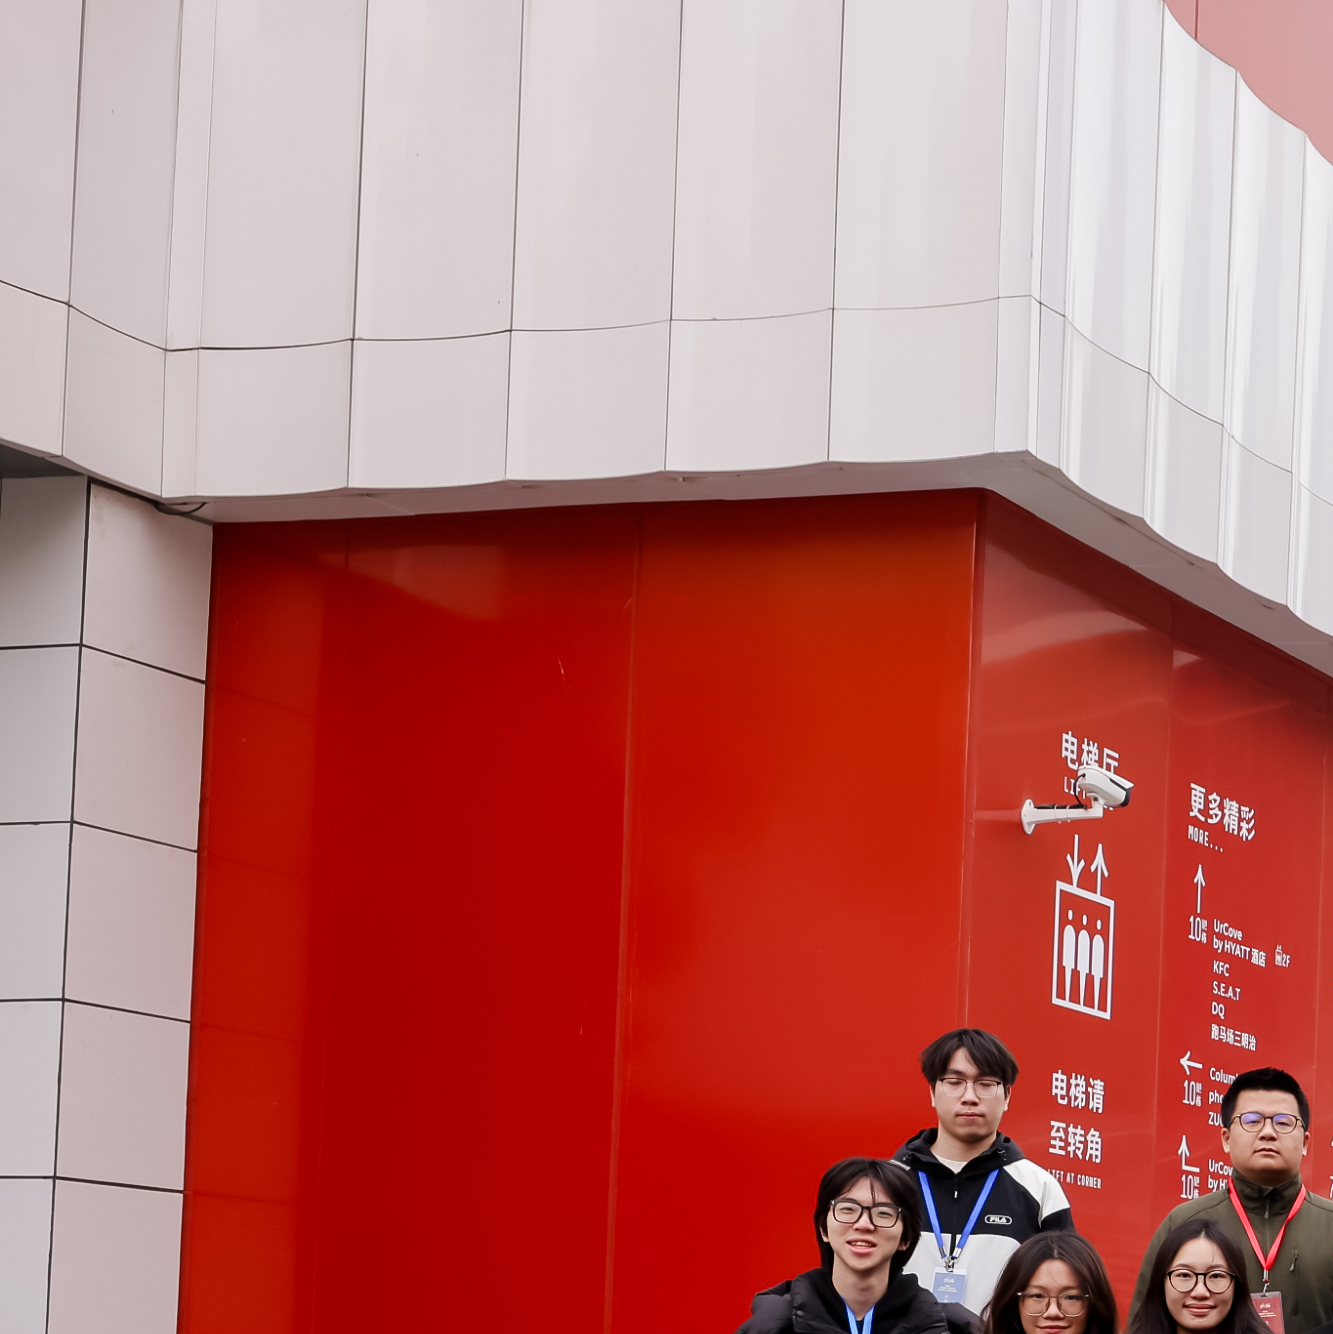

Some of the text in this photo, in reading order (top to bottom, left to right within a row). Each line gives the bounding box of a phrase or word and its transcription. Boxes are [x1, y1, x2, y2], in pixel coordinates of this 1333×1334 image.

[1189, 782, 1256, 842] 更多精彩
[1187, 824, 1223, 853] MORE...
[1213, 918, 1243, 941] UrCove
[1213, 934, 1223, 953] by
[1224, 939, 1250, 960] HYATT
[1213, 959, 1230, 977] KFC
[1211, 1001, 1225, 1019] DQ
[1211, 1023, 1257, 1051] 跑马场三明治
[1209, 1067, 1239, 1085] Colum
[1052, 1069, 1105, 1114] 电梯请
[1048, 1120, 1102, 1164] 至转角
[1208, 1158, 1234, 1177] UrCov
[1066, 1172, 1075, 1184] AT
[1077, 1174, 1102, 1190] CORNER
[1208, 1174, 1219, 1193] by
